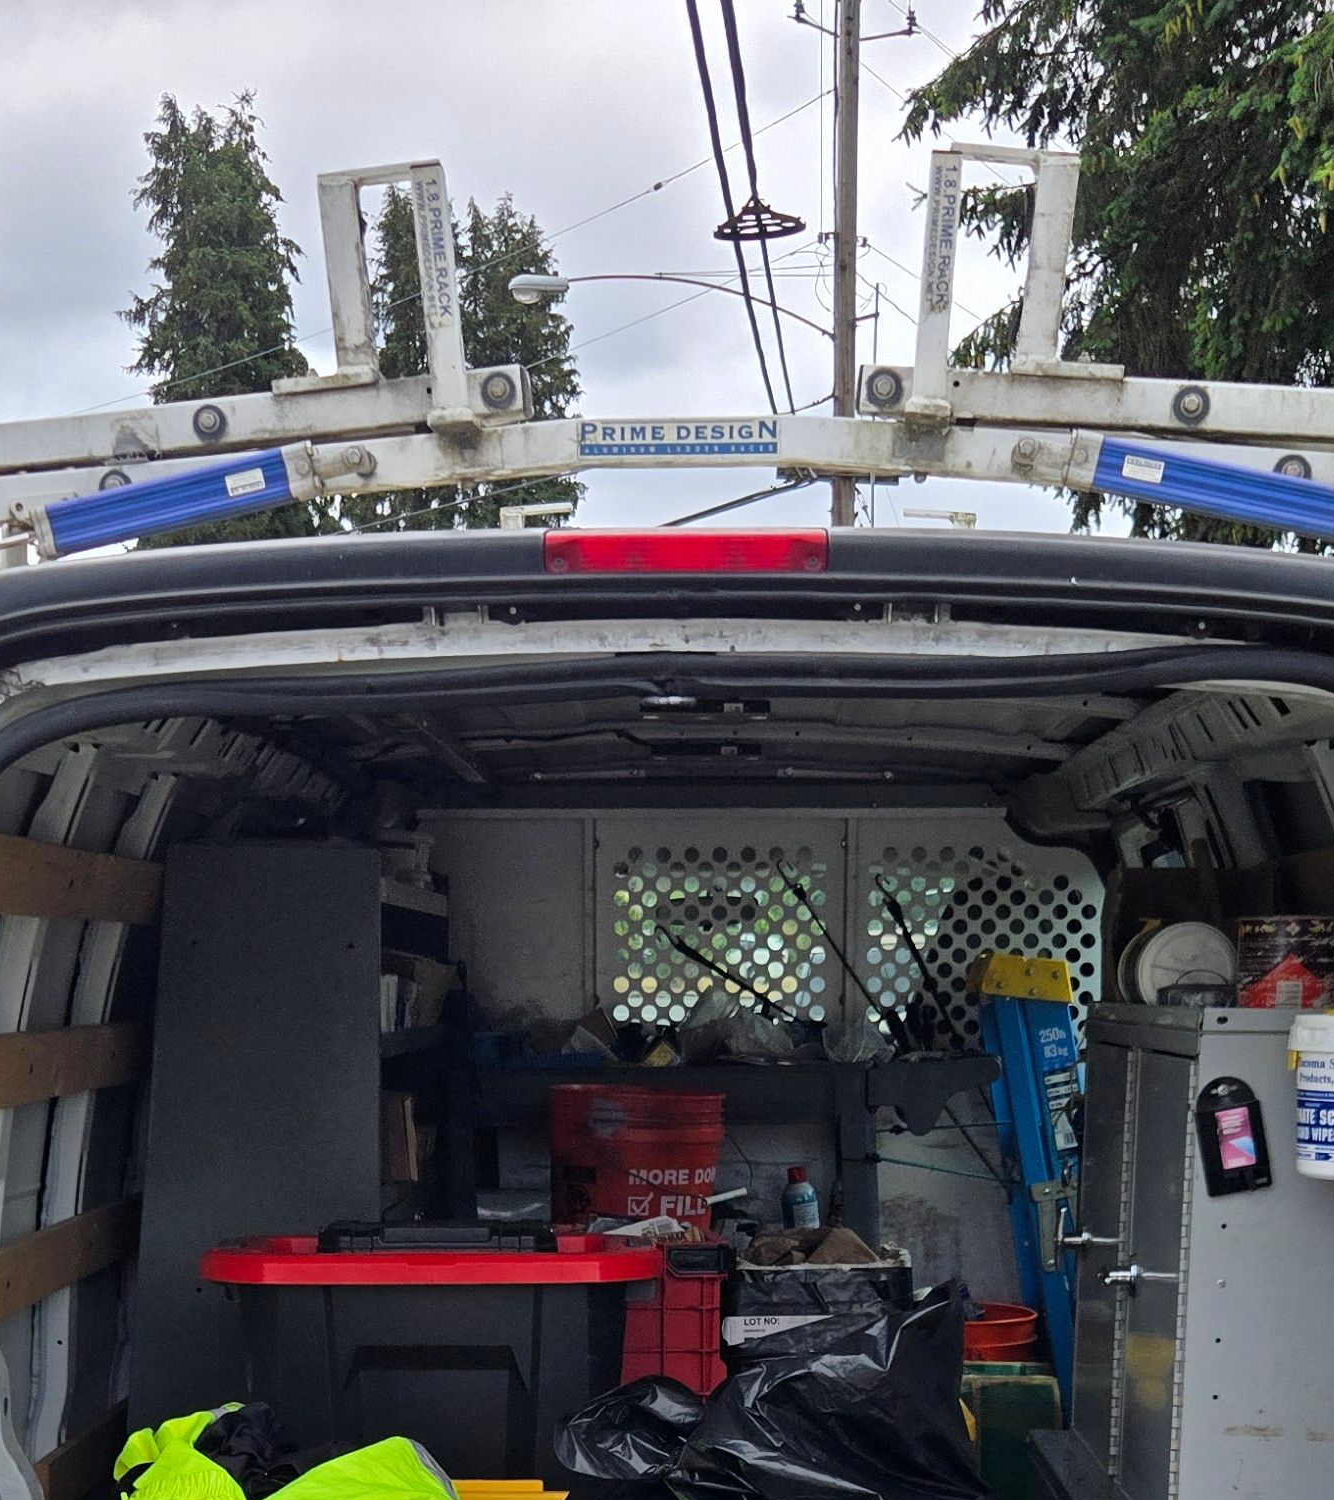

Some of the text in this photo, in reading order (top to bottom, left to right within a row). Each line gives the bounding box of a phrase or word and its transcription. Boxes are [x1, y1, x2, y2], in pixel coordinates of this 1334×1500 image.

[579, 420, 778, 442] PRIME DESIGN
[628, 1168, 690, 1185] MORE
[743, 1317, 780, 1326] LOT NO:
